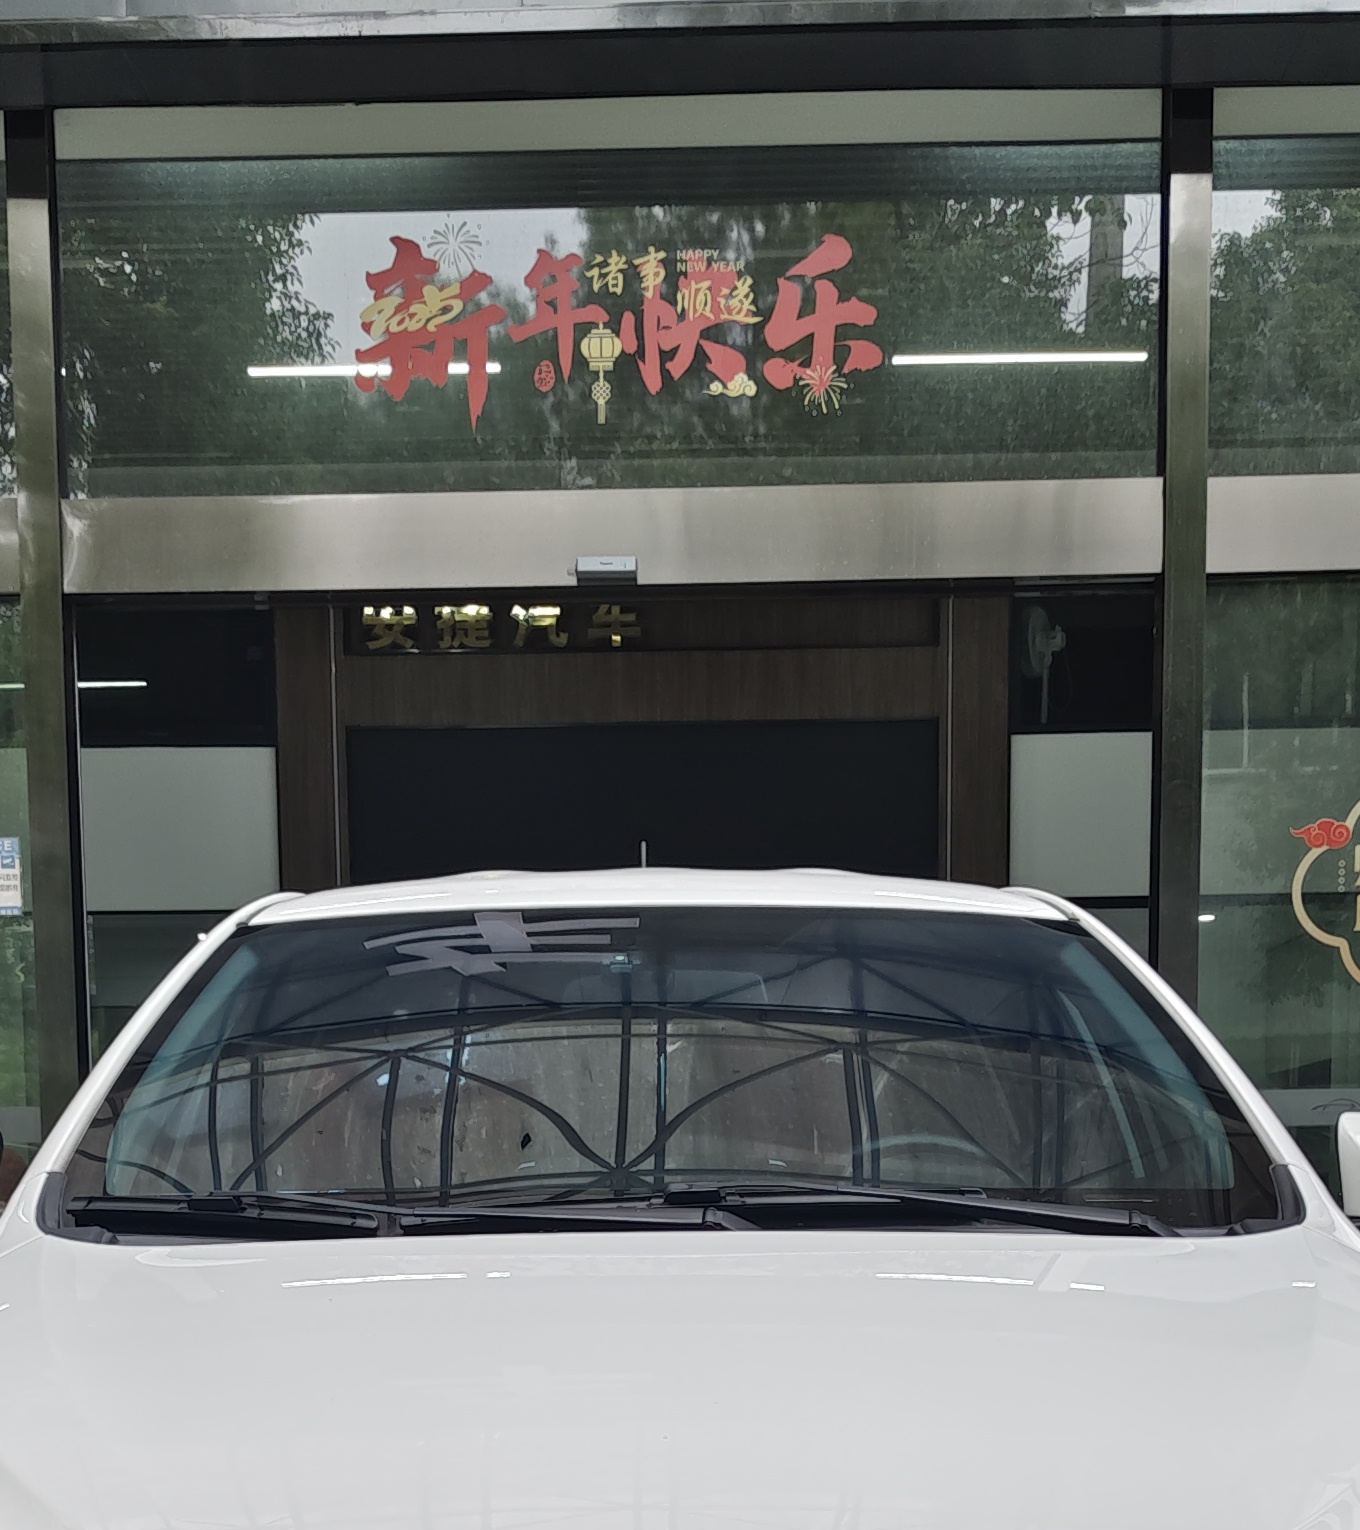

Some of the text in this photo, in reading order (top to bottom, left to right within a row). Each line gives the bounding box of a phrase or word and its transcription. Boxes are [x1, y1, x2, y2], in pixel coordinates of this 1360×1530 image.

[676, 249, 720, 260] HAPPY
[676, 261, 745, 272] NEW YEAR
[354, 233, 883, 435] 新年快乐
